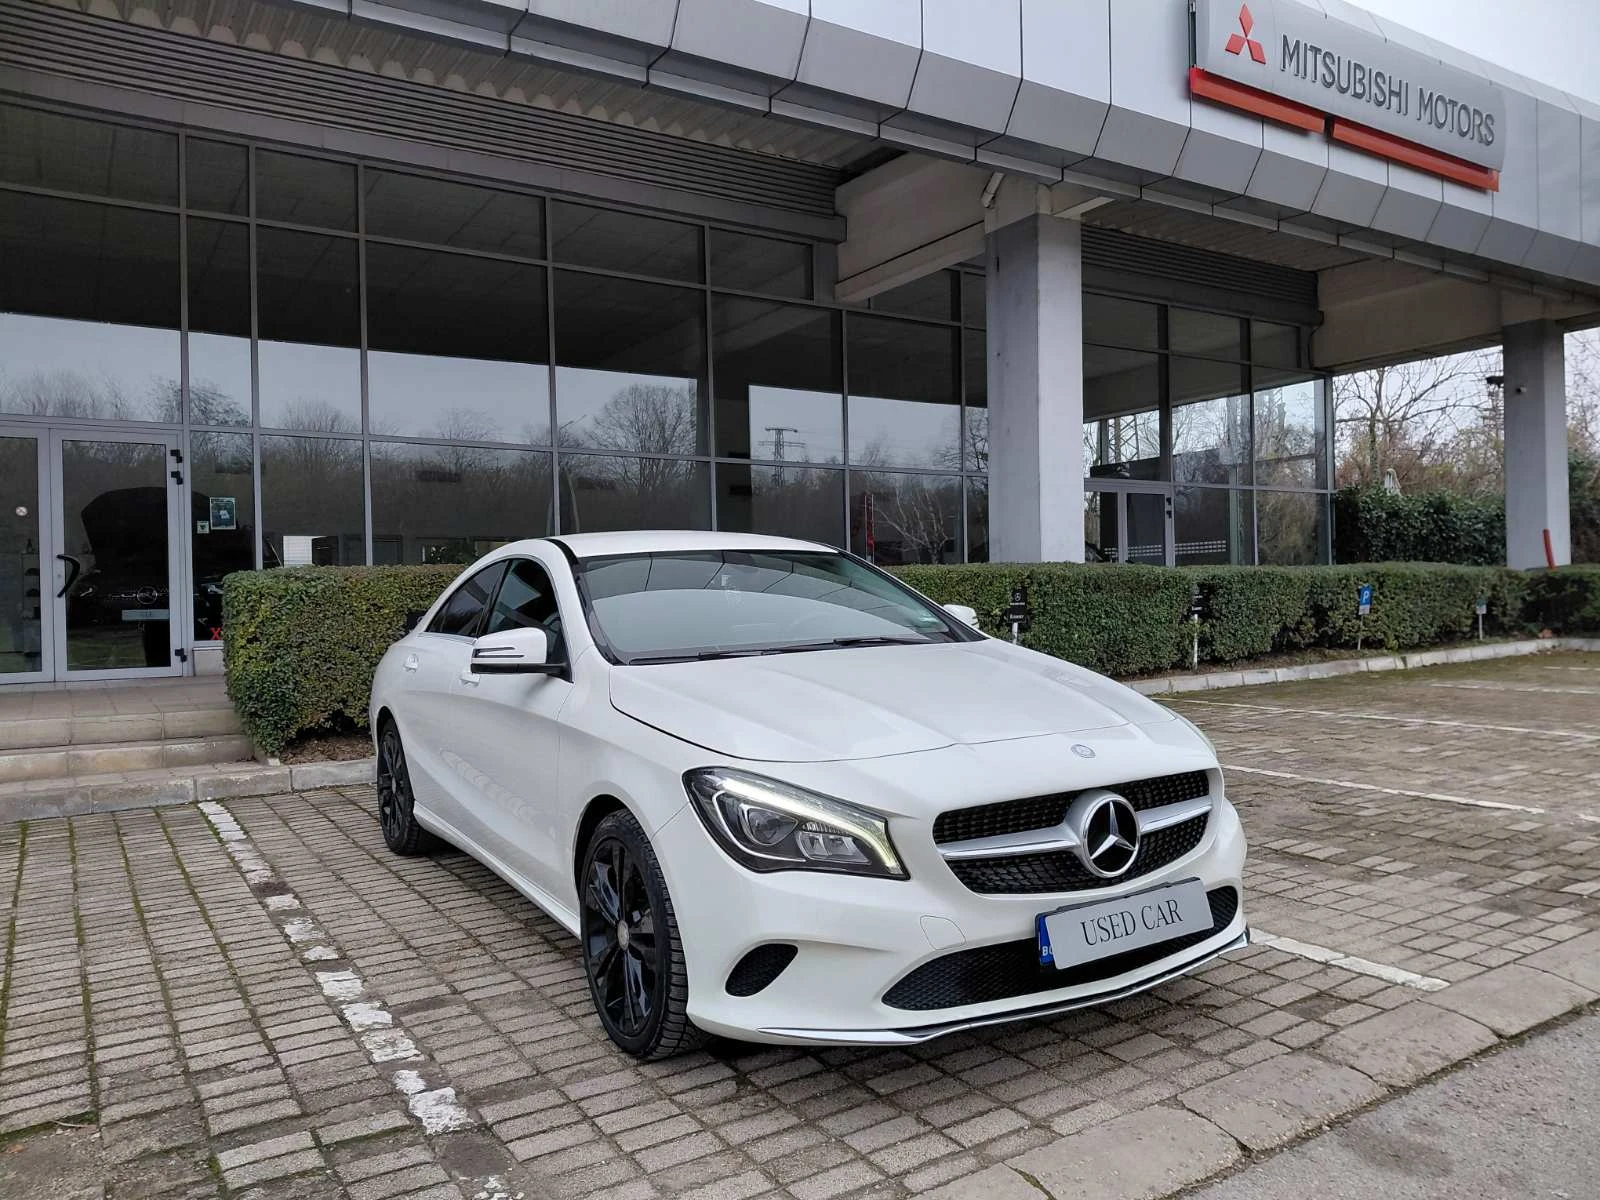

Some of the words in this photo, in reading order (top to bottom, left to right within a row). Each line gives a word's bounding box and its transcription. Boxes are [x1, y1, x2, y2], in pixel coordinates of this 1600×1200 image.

[1281, 34, 1408, 116] MITSUBISHI
[1416, 87, 1495, 145] MOTORS
[1081, 910, 1136, 946] USED
[1141, 899, 1183, 930] CAR
